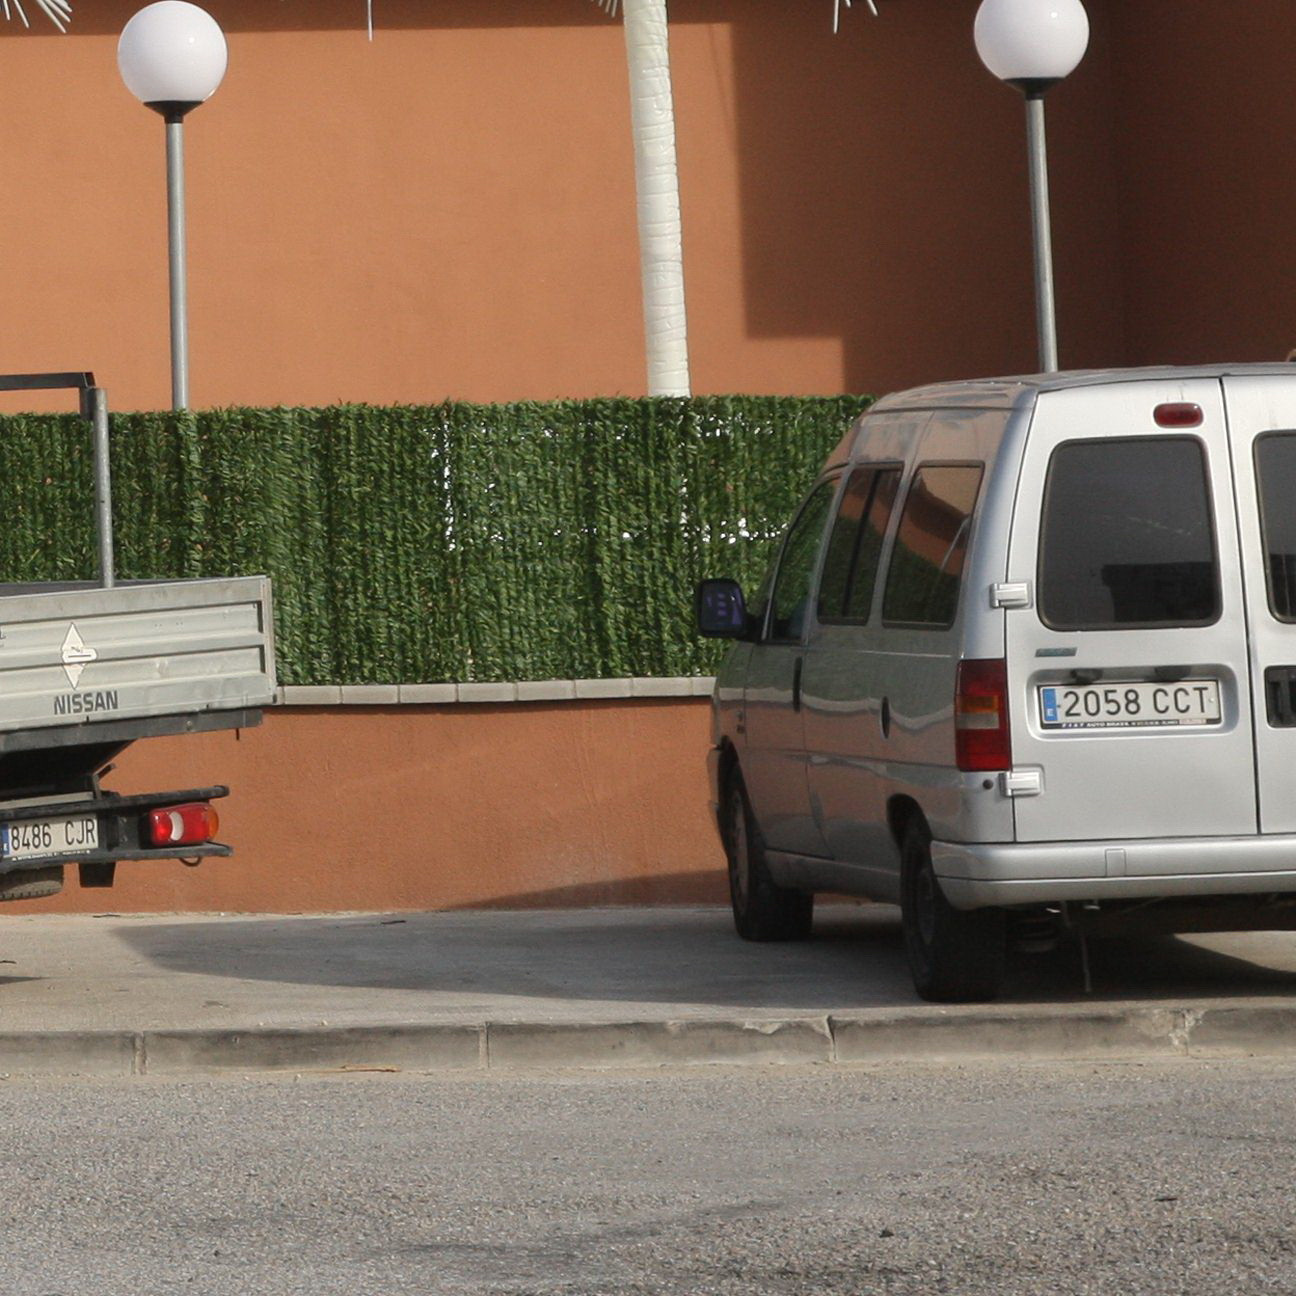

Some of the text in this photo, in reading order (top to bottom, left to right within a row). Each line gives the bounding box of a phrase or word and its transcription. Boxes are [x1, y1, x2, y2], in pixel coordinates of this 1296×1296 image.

[53, 690, 119, 715] NISSAN
[1063, 689, 1141, 718] 2058
[1151, 686, 1210, 715] CCT
[10, 823, 52, 851] 8486
[64, 818, 96, 846] CJR
